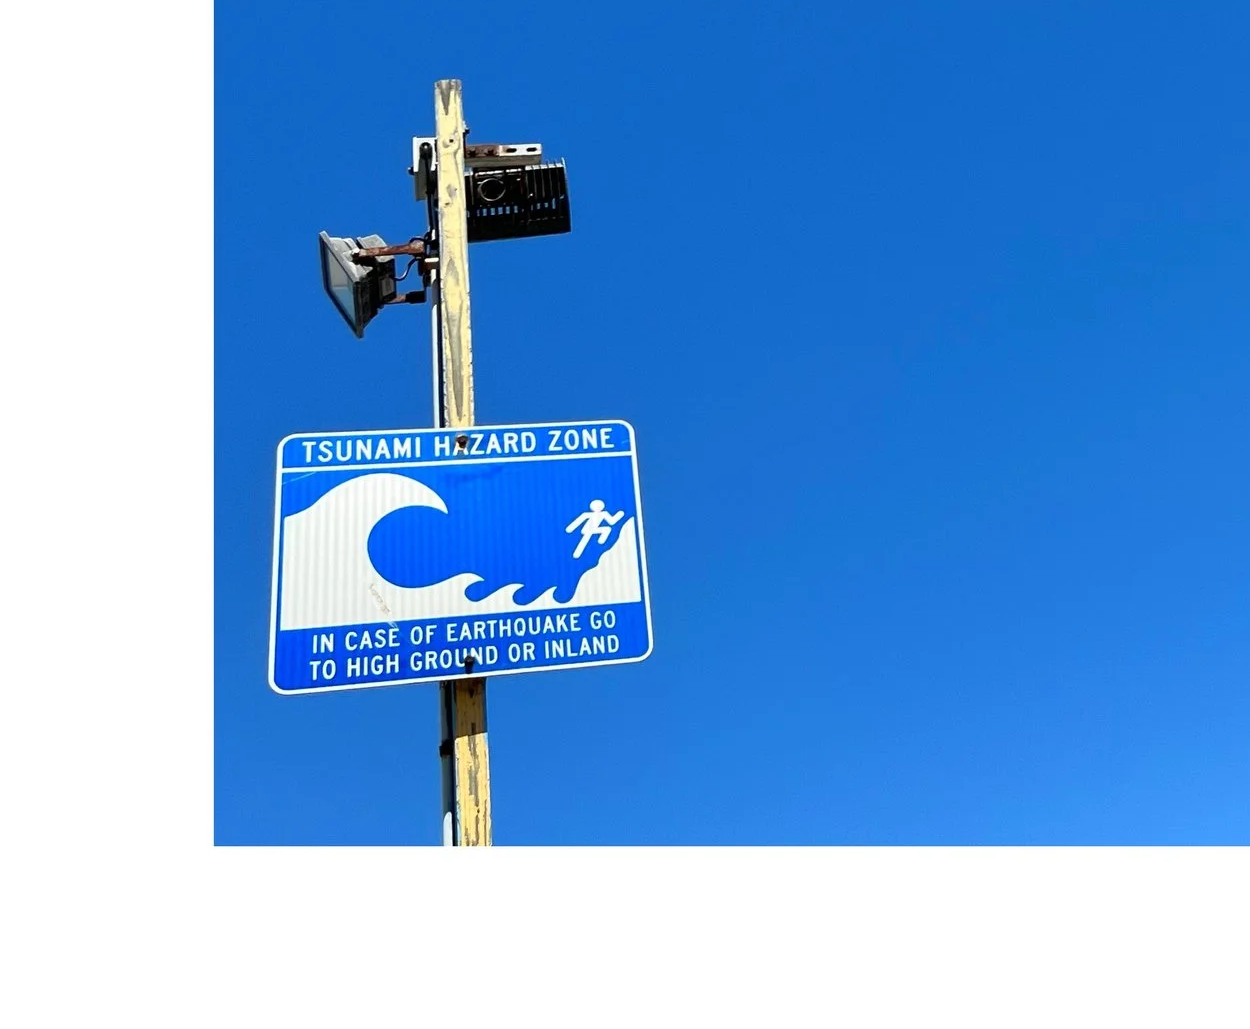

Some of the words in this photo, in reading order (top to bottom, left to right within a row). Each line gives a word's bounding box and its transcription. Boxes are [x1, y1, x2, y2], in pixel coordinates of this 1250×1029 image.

[302, 439, 421, 463] TSUNAMI
[548, 427, 615, 450] ZONE
[312, 633, 334, 653] IN
[344, 628, 400, 650] CASE
[410, 624, 437, 646] OF
[446, 613, 581, 643] EARTHQUAKE
[590, 610, 616, 630] GO
[309, 659, 336, 681] TO
[346, 654, 399, 677] HIGH
[409, 646, 498, 672] GROUND
[508, 643, 535, 662] OR
[544, 634, 620, 658] INLAND
